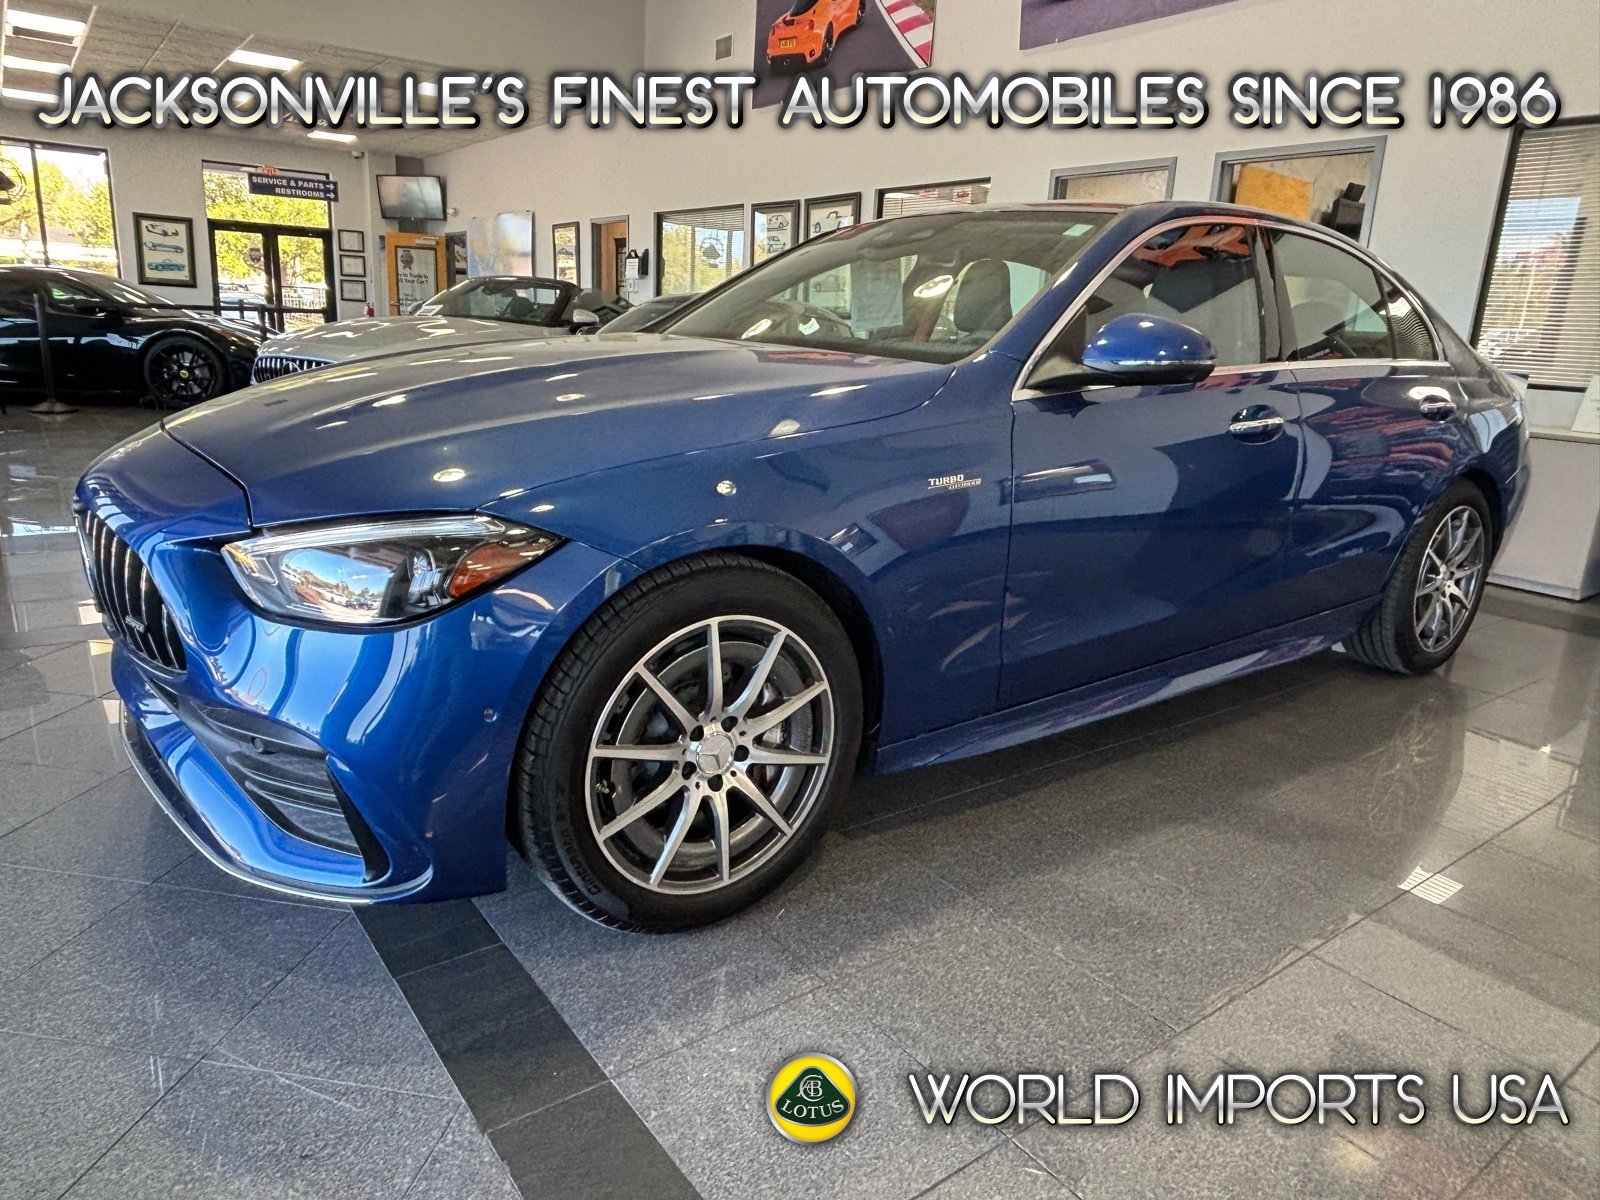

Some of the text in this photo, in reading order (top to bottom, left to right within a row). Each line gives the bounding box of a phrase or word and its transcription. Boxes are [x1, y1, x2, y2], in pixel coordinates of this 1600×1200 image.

[252, 176, 288, 185] SERVICE
[298, 181, 325, 190] PARTS
[275, 187, 325, 198] RESTROOMS
[928, 474, 964, 486] TURBO
